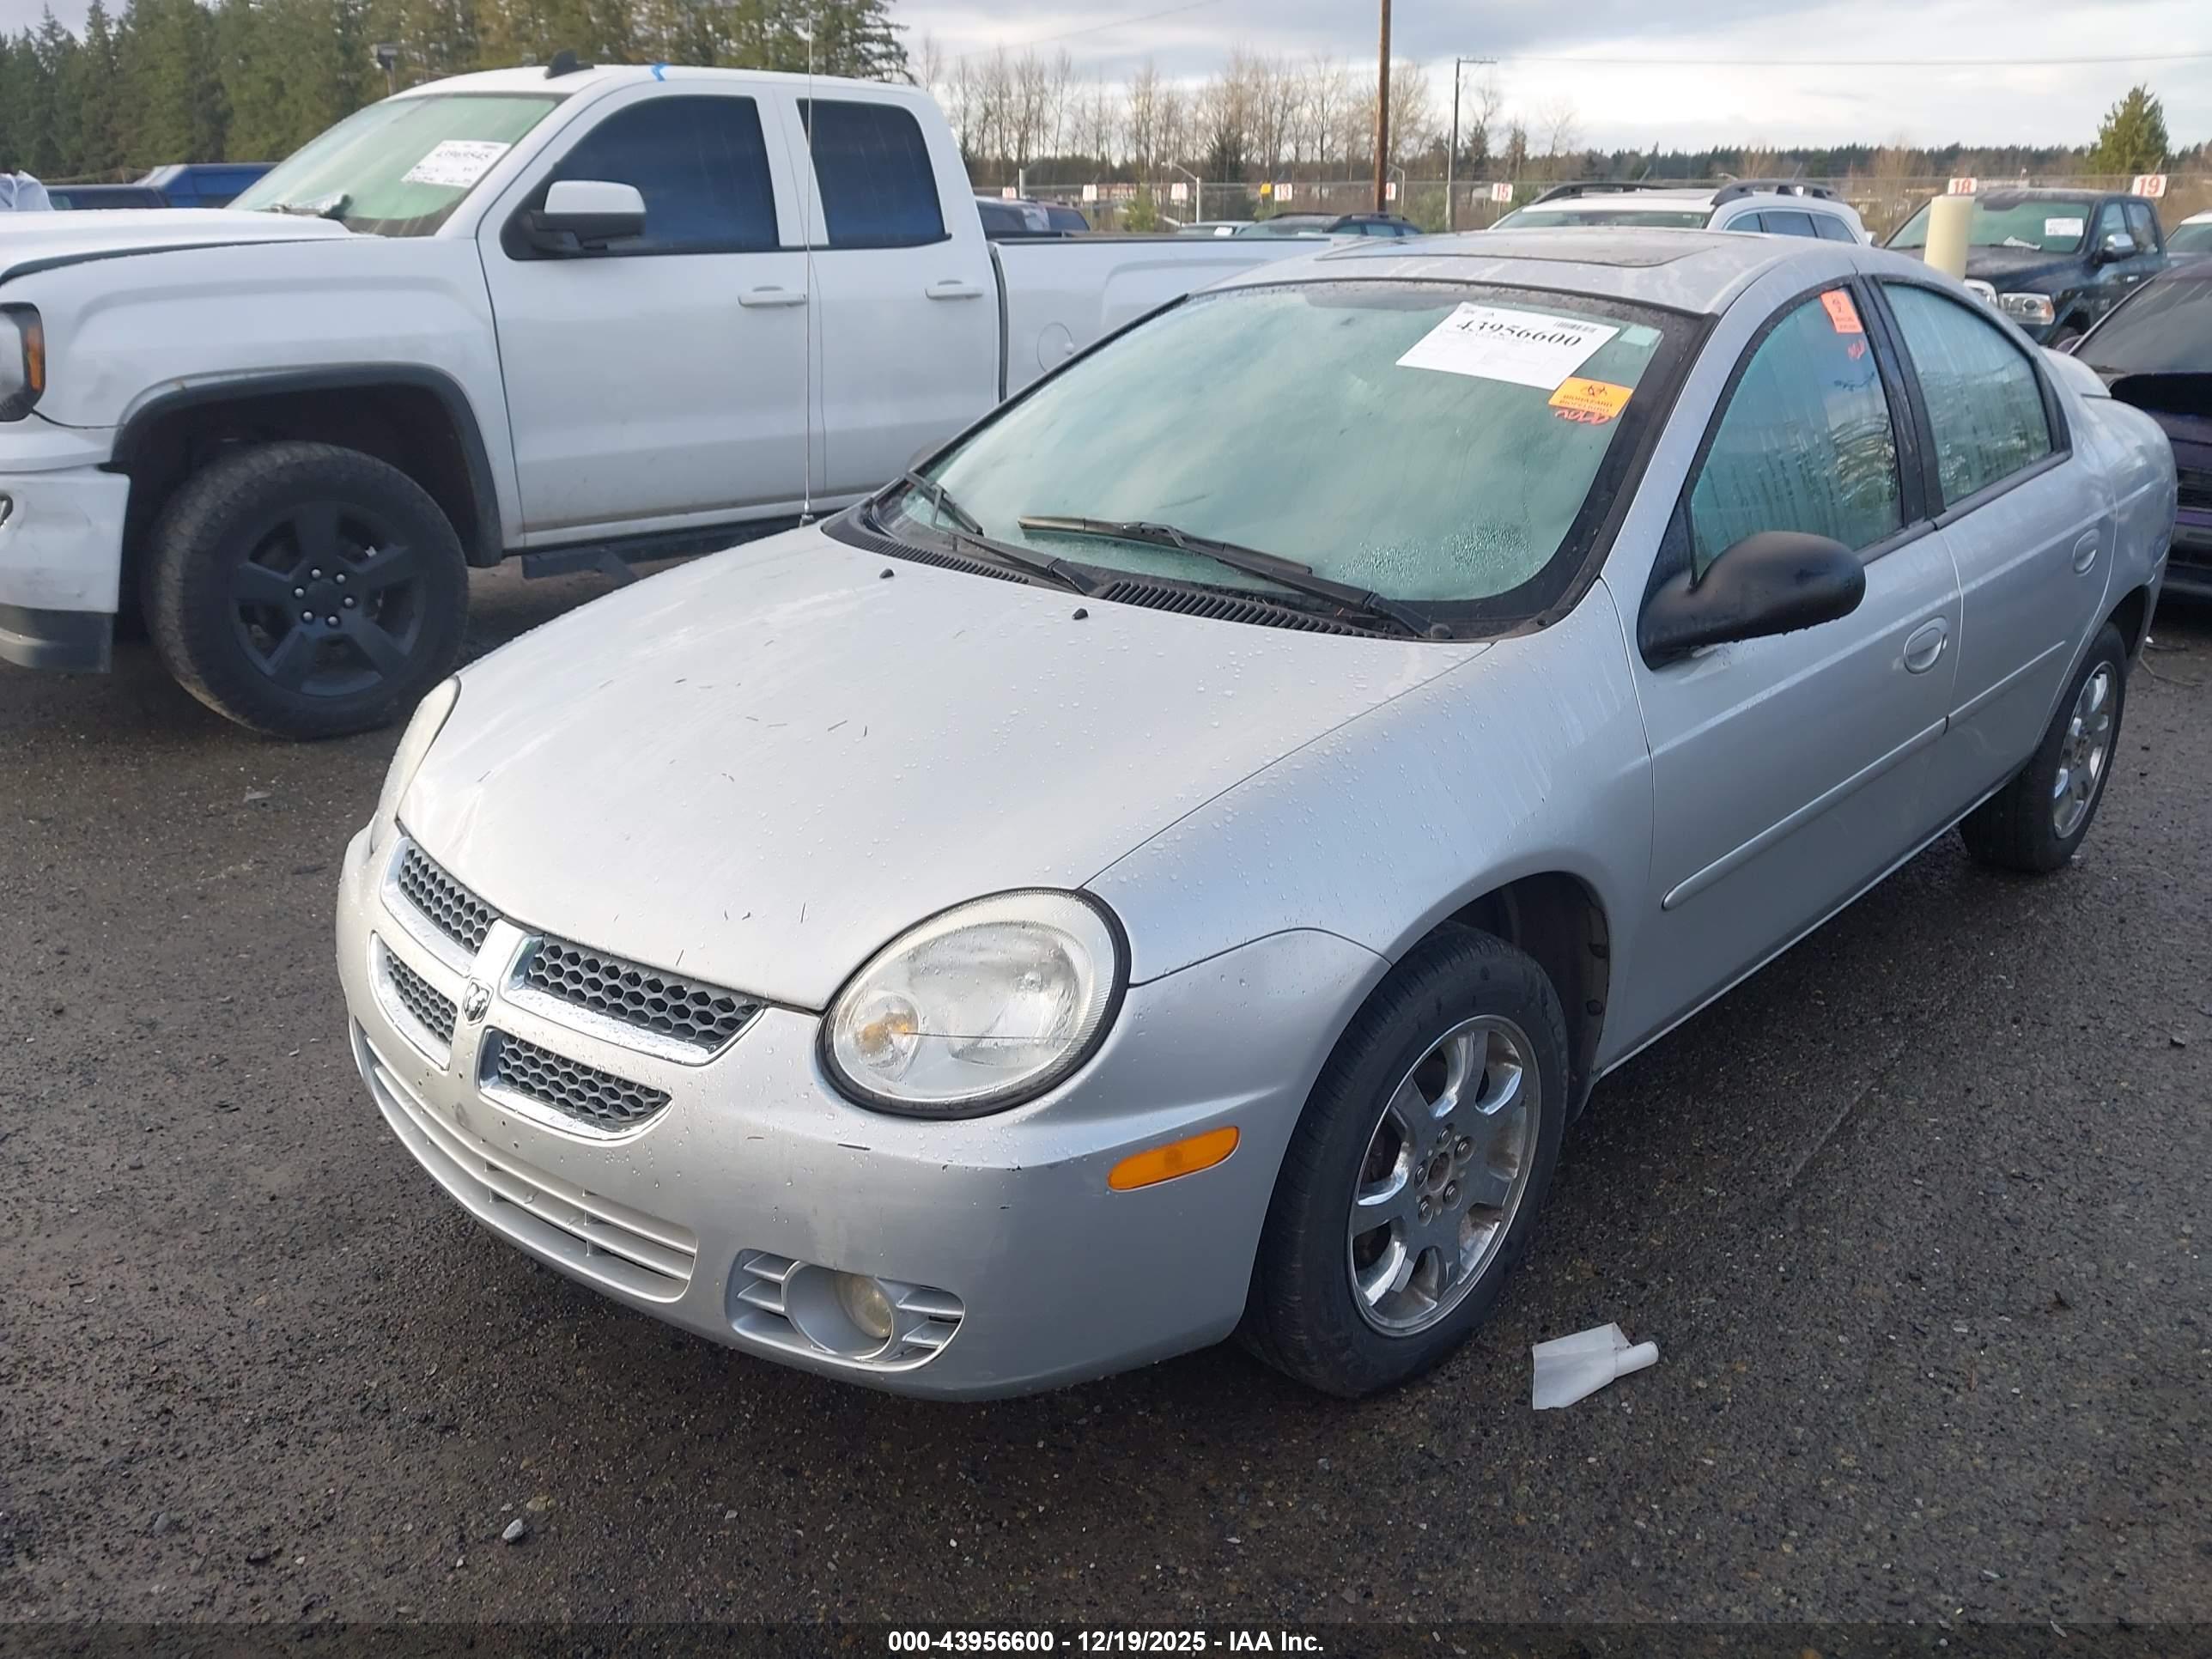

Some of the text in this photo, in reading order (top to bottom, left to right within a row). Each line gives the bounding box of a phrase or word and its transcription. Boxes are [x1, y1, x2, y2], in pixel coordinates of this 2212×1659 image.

[1497, 184, 1509, 199] 15
[1954, 179, 1972, 193] 18
[2139, 175, 2160, 196] 19
[1457, 319, 1582, 347] 43956600
